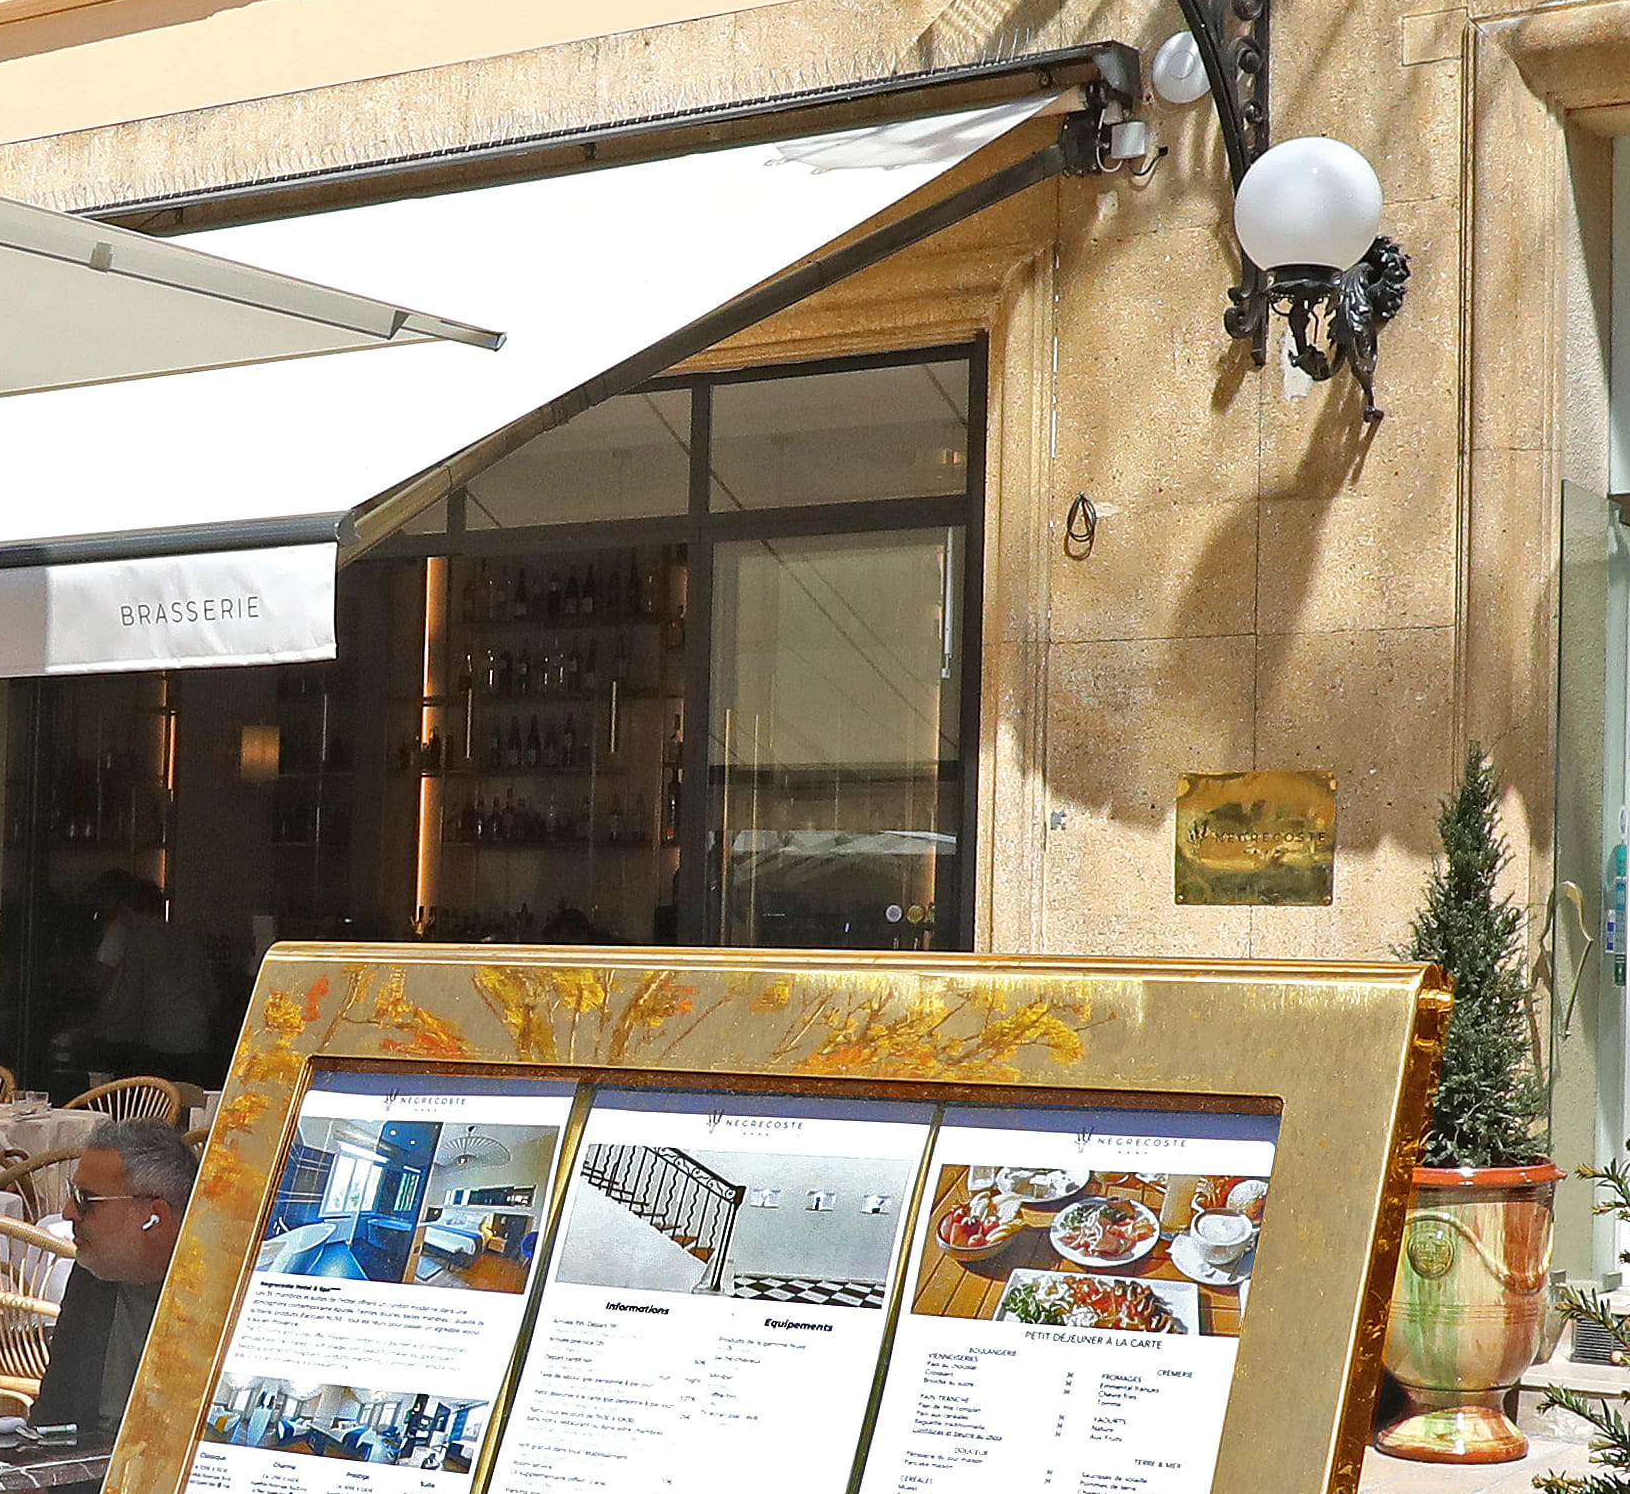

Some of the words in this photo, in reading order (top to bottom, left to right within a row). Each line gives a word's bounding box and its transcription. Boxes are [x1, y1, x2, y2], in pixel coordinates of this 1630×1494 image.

[120, 595, 260, 627] BRASSERIE
[604, 1300, 670, 1315] Informations
[763, 1317, 834, 1332] Equipements
[1129, 1337, 1162, 1350] CARTE
